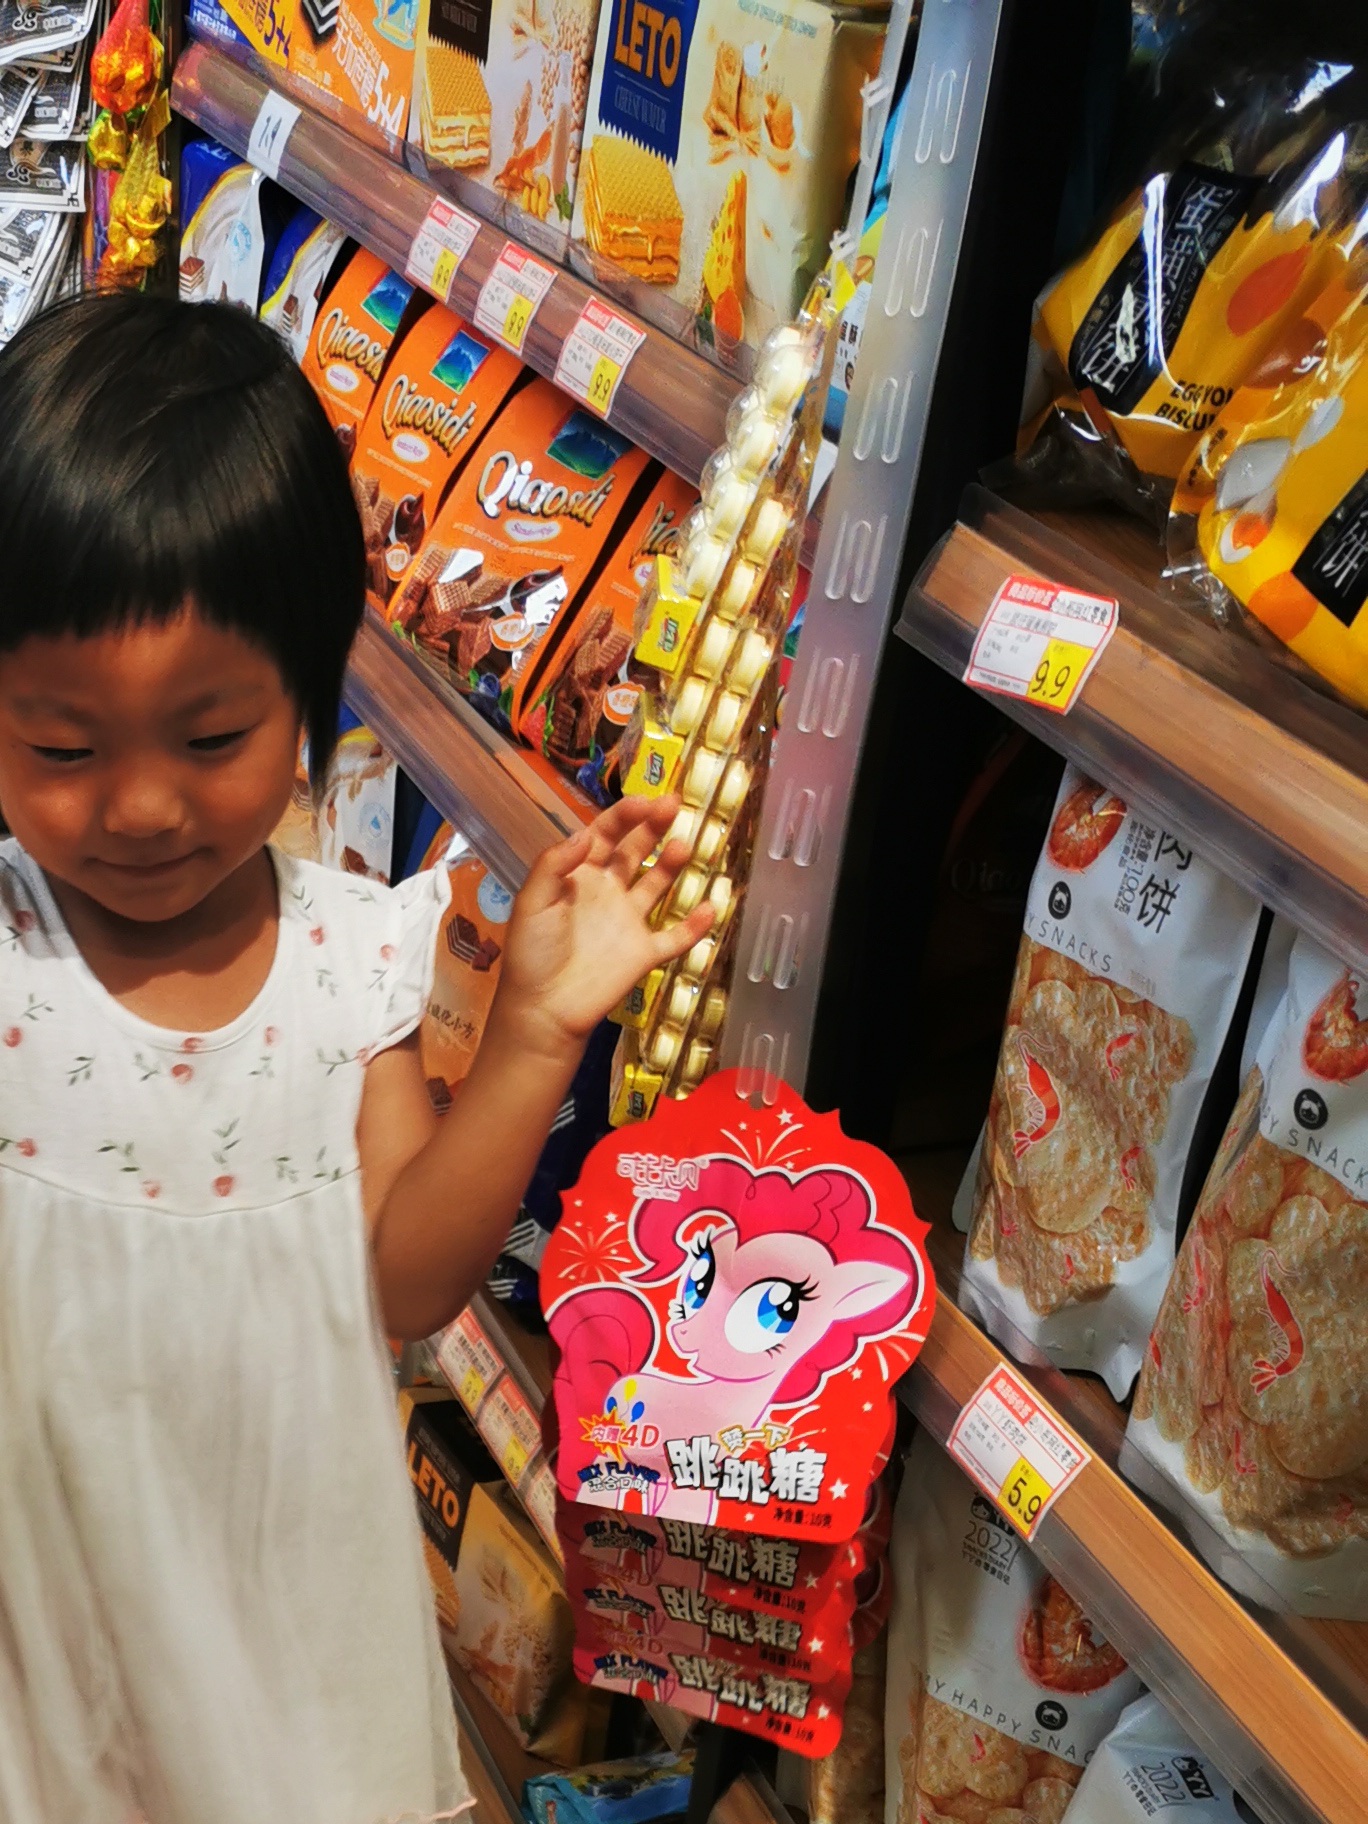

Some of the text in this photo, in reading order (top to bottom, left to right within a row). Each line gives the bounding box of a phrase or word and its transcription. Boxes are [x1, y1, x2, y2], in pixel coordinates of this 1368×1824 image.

[614, 0, 681, 88] LETO
[592, 373, 611, 403] 9.9
[1031, 659, 1071, 699] 9.9
[1037, 920, 1113, 974] SNACKS
[622, 1423, 661, 1448] 4D
[587, 1475, 650, 1494] 混合口味
[606, 1462, 661, 1484] FLAVOR
[666, 1435, 829, 1506] 跳跳糖
[1007, 1477, 1043, 1525] 5.9
[660, 1519, 801, 1589] 跳跳糖
[963, 1520, 1014, 1563] 2022
[658, 1585, 802, 1651] 跳跳糖
[950, 1687, 1023, 1734] HAPPY
[1140, 1761, 1186, 1803] 2022
